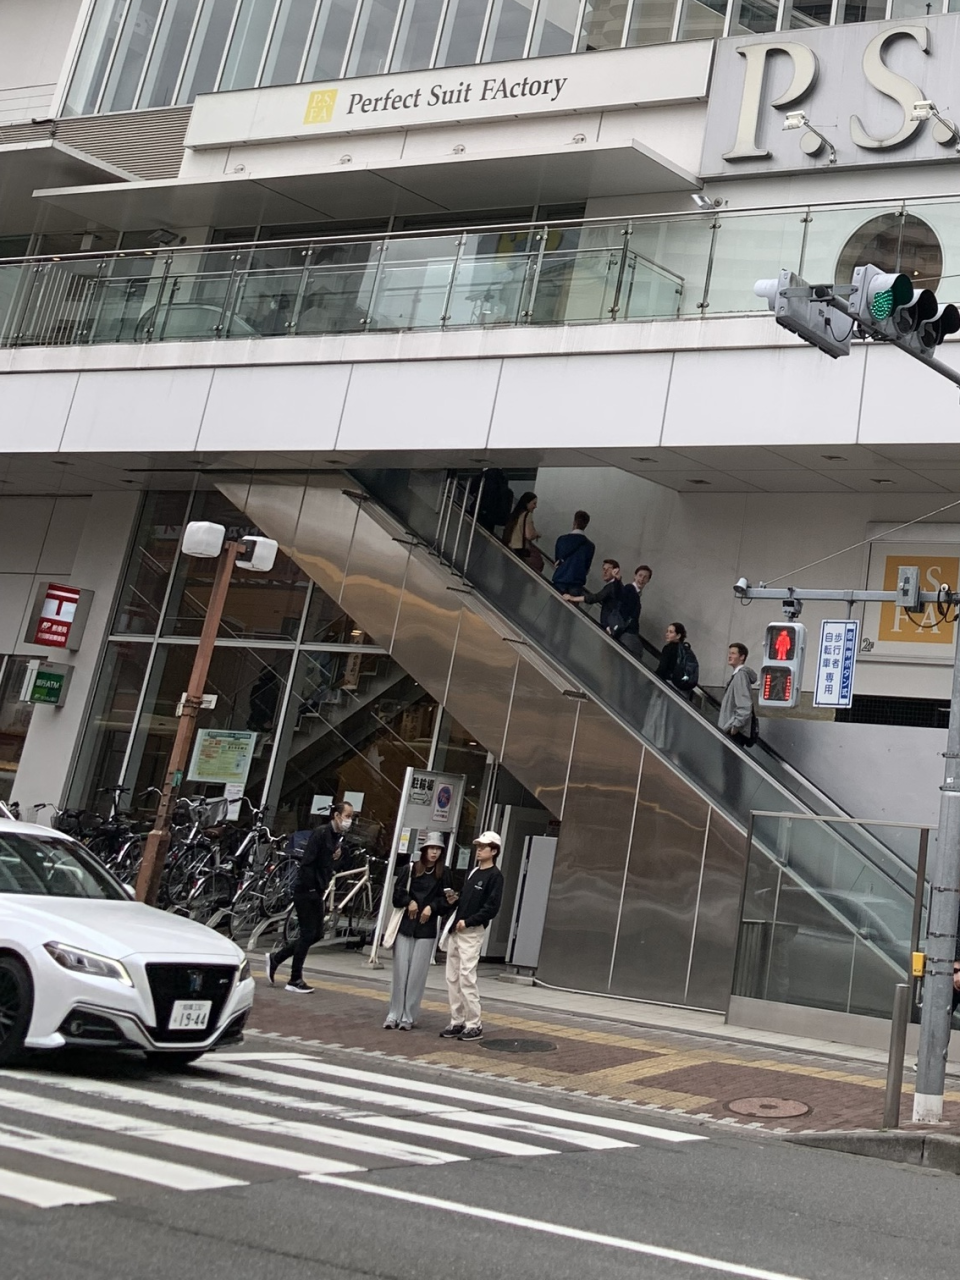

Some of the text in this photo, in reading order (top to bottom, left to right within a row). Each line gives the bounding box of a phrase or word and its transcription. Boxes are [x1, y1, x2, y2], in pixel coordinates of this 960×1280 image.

[346, 76, 568, 116] Perfect Suit FActory
[861, 638, 875, 652] 2F
[412, 777, 435, 792] 駐輪場
